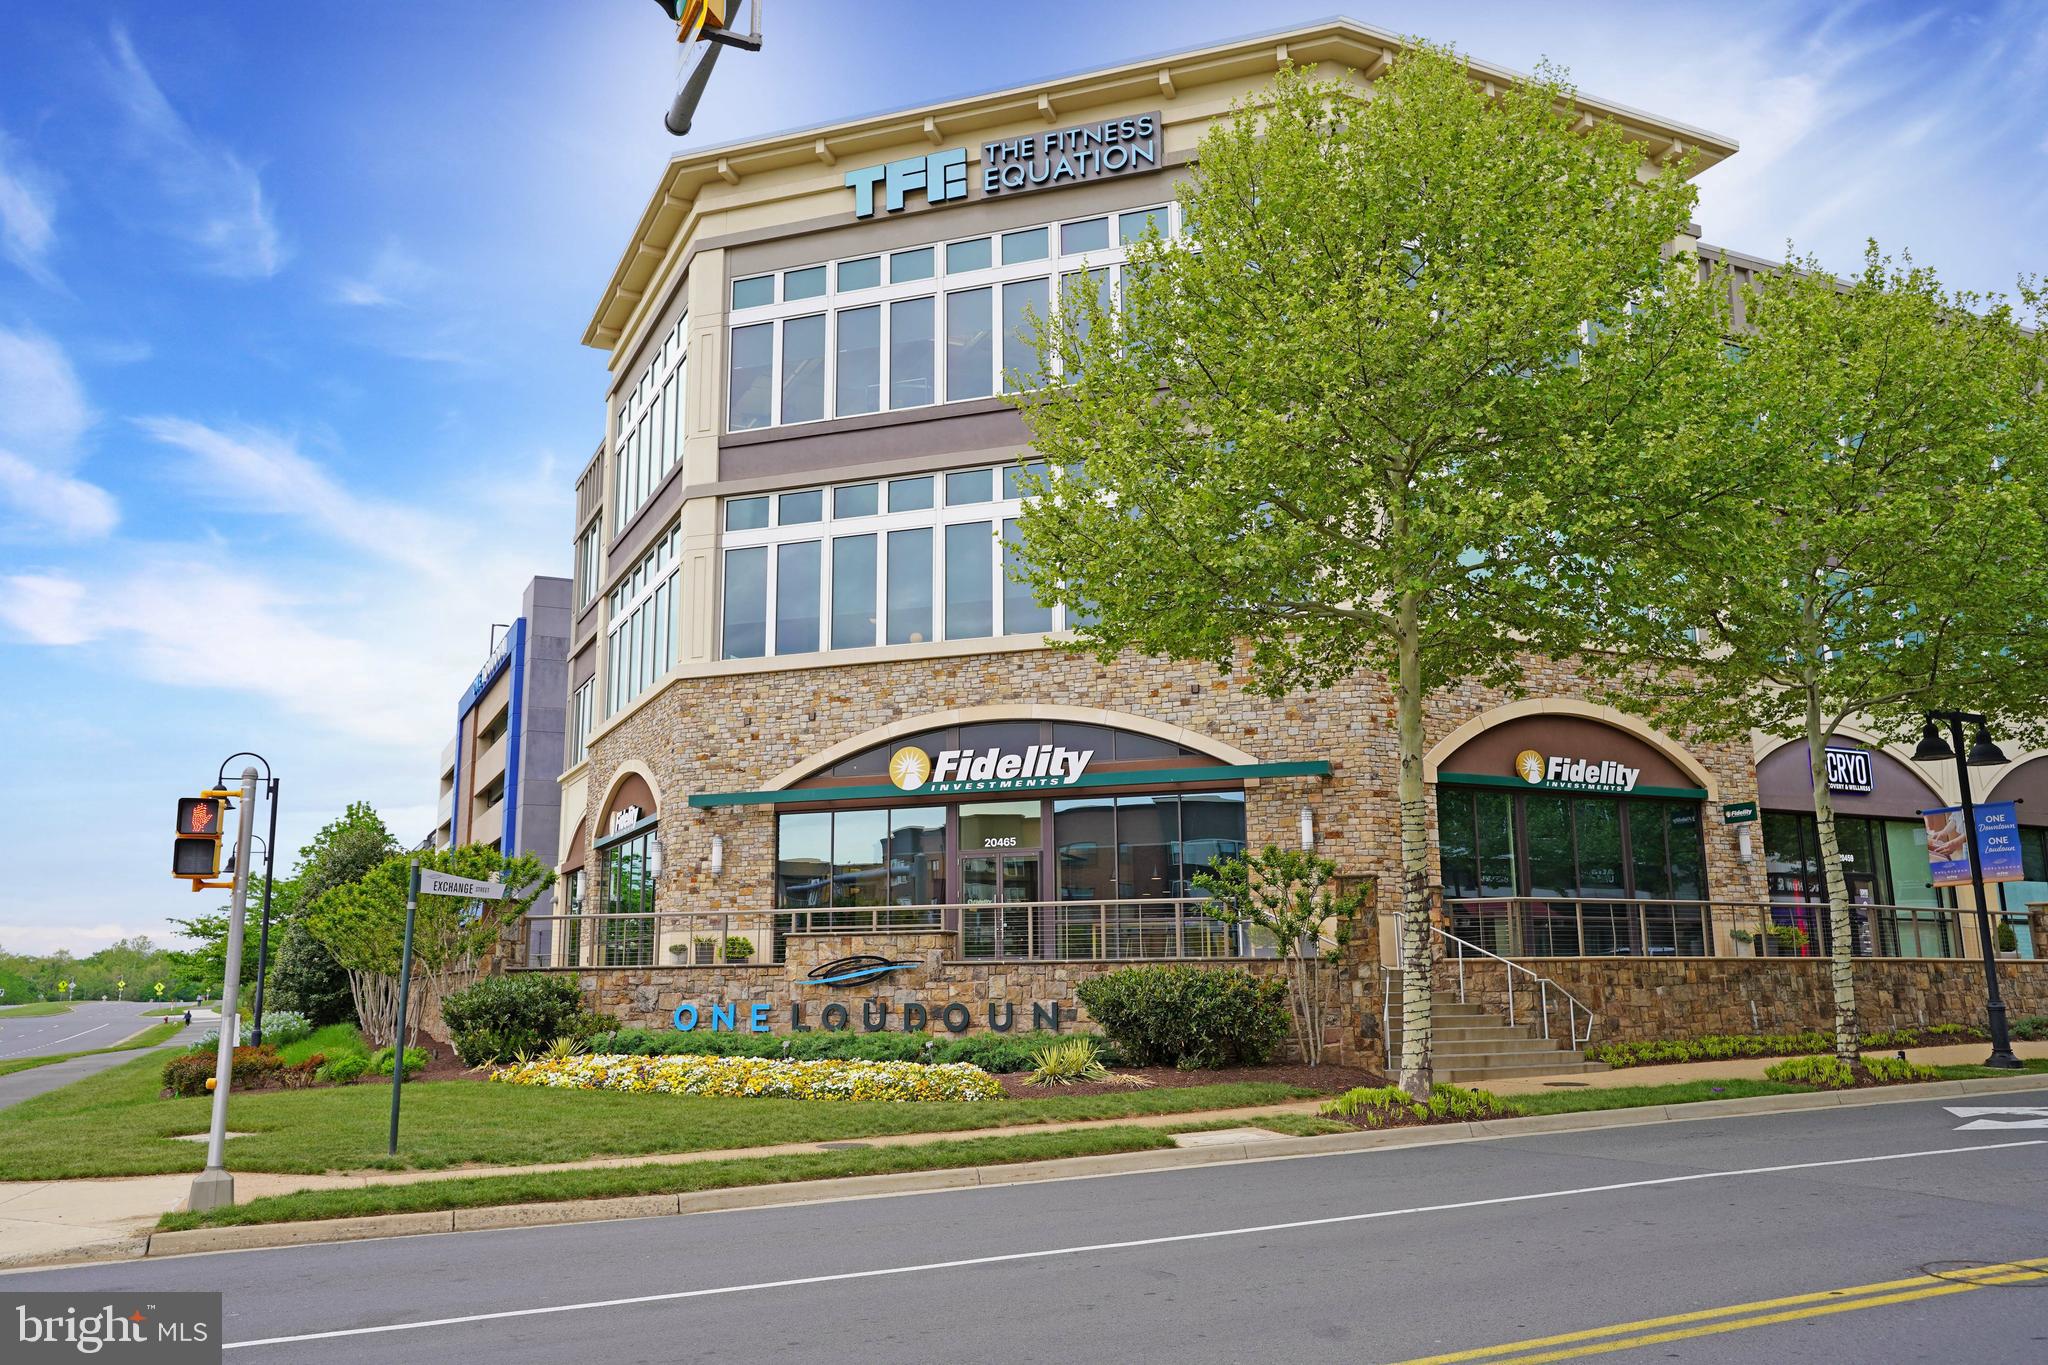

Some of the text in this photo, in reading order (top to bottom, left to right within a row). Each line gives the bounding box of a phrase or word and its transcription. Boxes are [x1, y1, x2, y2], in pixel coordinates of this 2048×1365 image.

[985, 116, 1154, 164] THE FITNESS
[984, 140, 1155, 193] EQUATION
[845, 147, 968, 219] TFE
[932, 744, 1095, 784] Fidelity
[1547, 756, 1640, 792] Fidelity
[931, 778, 1059, 791] INVESTMENTS
[1546, 781, 1622, 791] INVESTMENTS
[1849, 784, 1871, 792] WELLNESS
[1731, 809, 1752, 817] Fidelity
[1985, 814, 2006, 823] ONE
[1978, 823, 2016, 832] Downtown
[984, 837, 1017, 847] 20465
[1988, 836, 2009, 844] ONE
[1984, 845, 2015, 854] Loudoun
[433, 880, 474, 894] EXCHANGE
[673, 1001, 1061, 1033] ONE LOUDOUN
